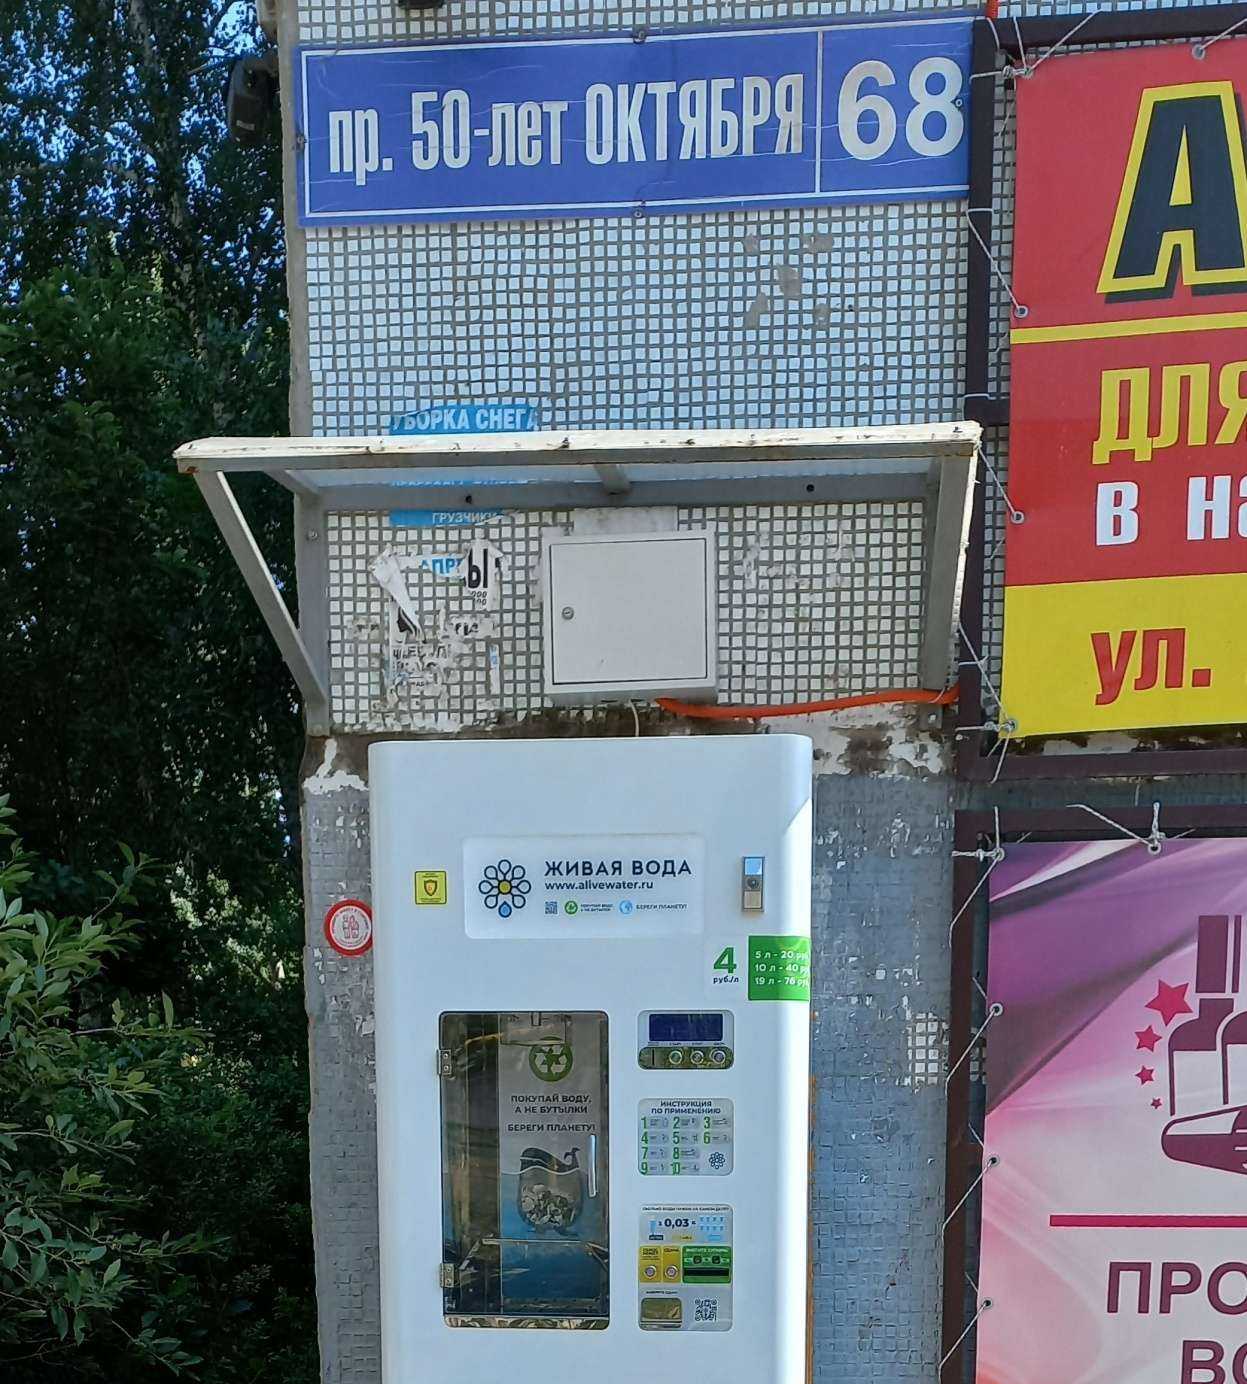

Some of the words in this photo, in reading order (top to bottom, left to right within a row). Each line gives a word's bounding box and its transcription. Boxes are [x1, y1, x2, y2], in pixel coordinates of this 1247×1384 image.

[329, 107, 394, 186] пр.
[410, 88, 569, 170] 50-лет
[585, 73, 804, 166] ОКТЯБРЯ
[837, 56, 965, 161] 68
[1186, 474, 1247, 541] н
[1090, 627, 1211, 706] ул.
[544, 860, 622, 876] ЖИВАЯ
[632, 859, 692, 877] ВОДА
[544, 879, 654, 890] www.alivewater.ru
[713, 946, 737, 974] 4
[755, 951, 762, 959] 5
[781, 950, 794, 959] 20
[755, 963, 767, 972] 10
[785, 963, 799, 971] 40
[755, 976, 766, 985] 19
[784, 976, 796, 985] 76
[511, 1093, 559, 1103] ПОКУПАЙ
[508, 1123, 544, 1131] БЕРЕГИ
[547, 1123, 595, 1132] ПЛАНЕТУ!
[641, 1116, 647, 1129] 1
[673, 1116, 680, 1129] 2
[704, 1116, 711, 1129] 3
[641, 1132, 648, 1145] 4
[673, 1132, 680, 1145] 5
[704, 1132, 711, 1145] 6
[641, 1147, 648, 1159] 7
[673, 1147, 680, 1159] 8
[641, 1162, 648, 1175] 9
[664, 1218, 690, 1229] 0,03
[1106, 1261, 1247, 1315] ПРО
